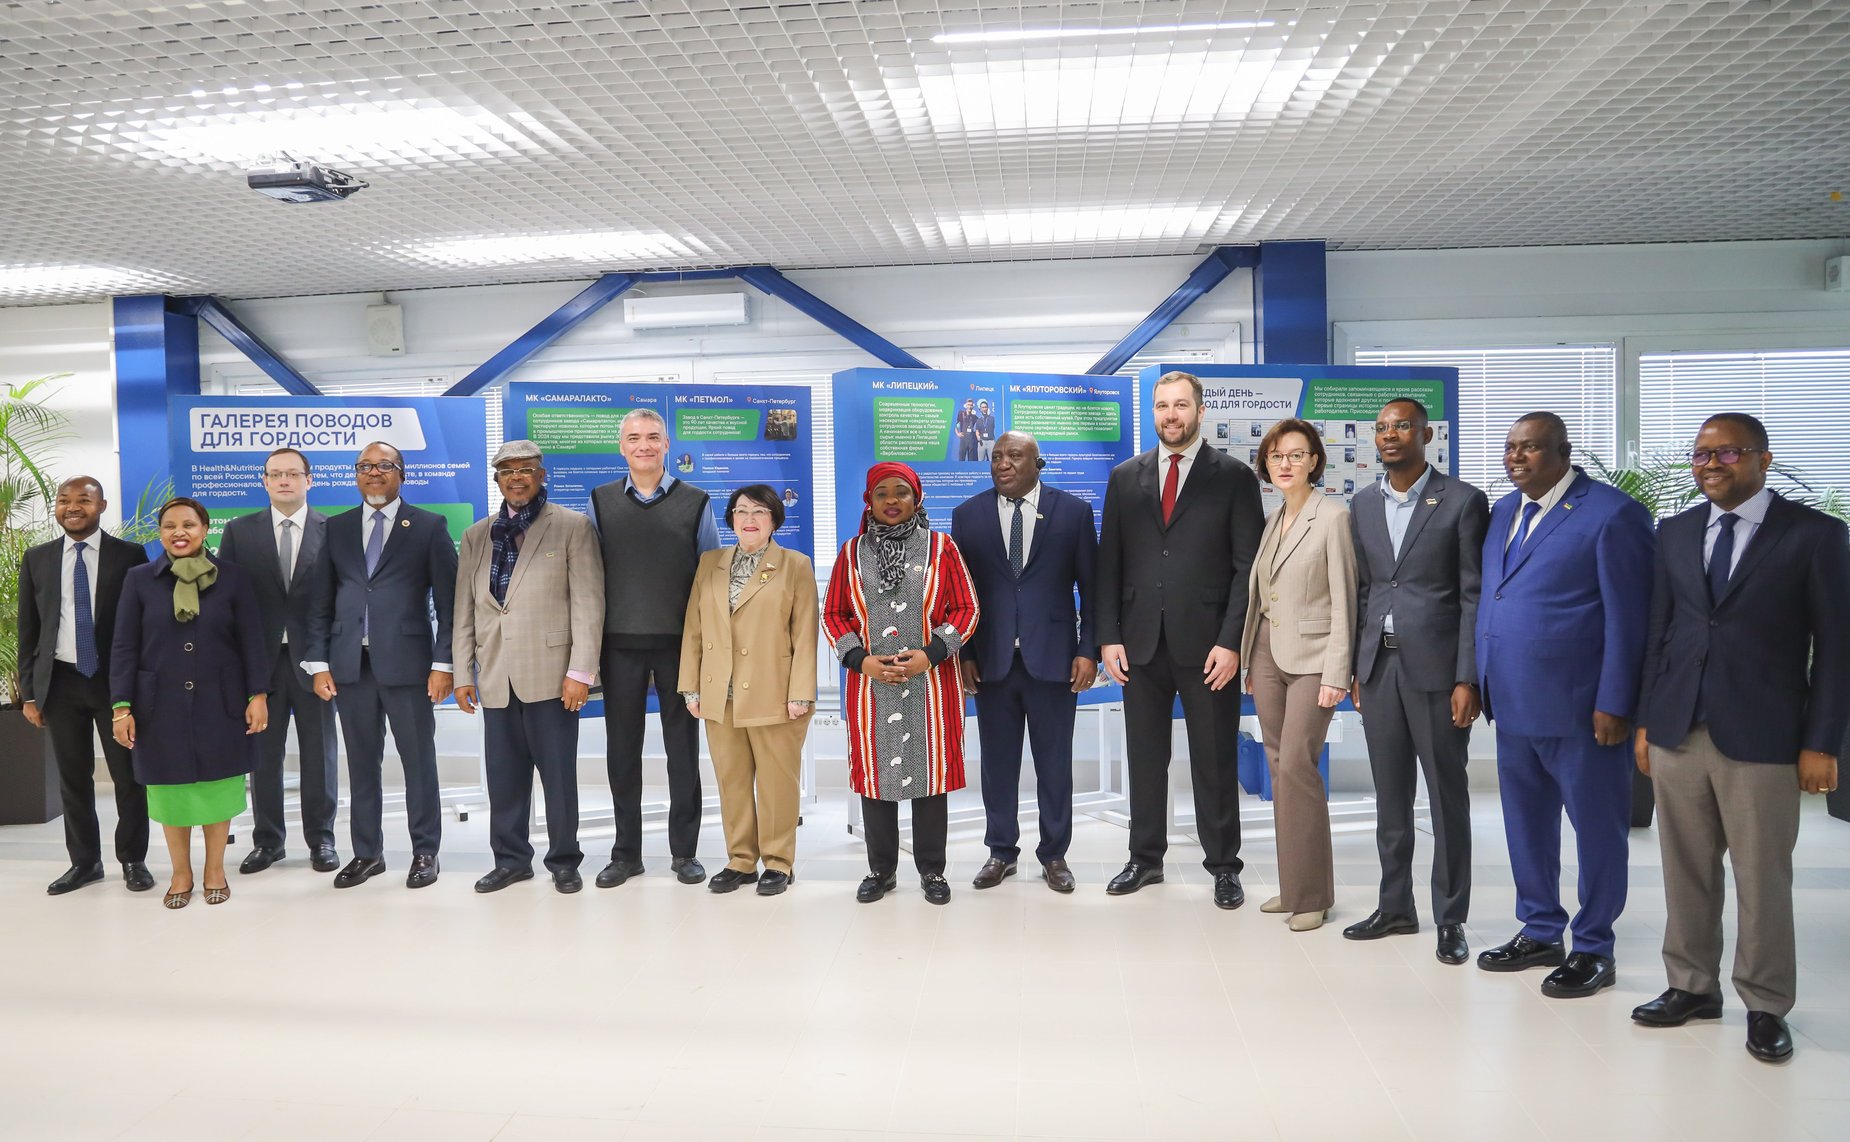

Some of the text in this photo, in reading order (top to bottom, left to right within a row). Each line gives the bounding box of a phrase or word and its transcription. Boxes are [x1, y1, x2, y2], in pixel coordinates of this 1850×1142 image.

[886, 381, 938, 390] «ЛИПЕЦКИЙ»
[1022, 385, 1087, 394] «ЯЛУТОРОВСКИЙ»
[1228, 389, 1253, 398] ДЕНЬ
[1220, 401, 1240, 409] ДЛЯ
[1242, 401, 1292, 409] ГОРДОСТИ
[200, 414, 392, 430] ГАЛЕРЕЯ ПОВОДОВ
[200, 431, 356, 448] ДЛЯ ГОРДОСТИ
[314, 464, 351, 472] продукты
